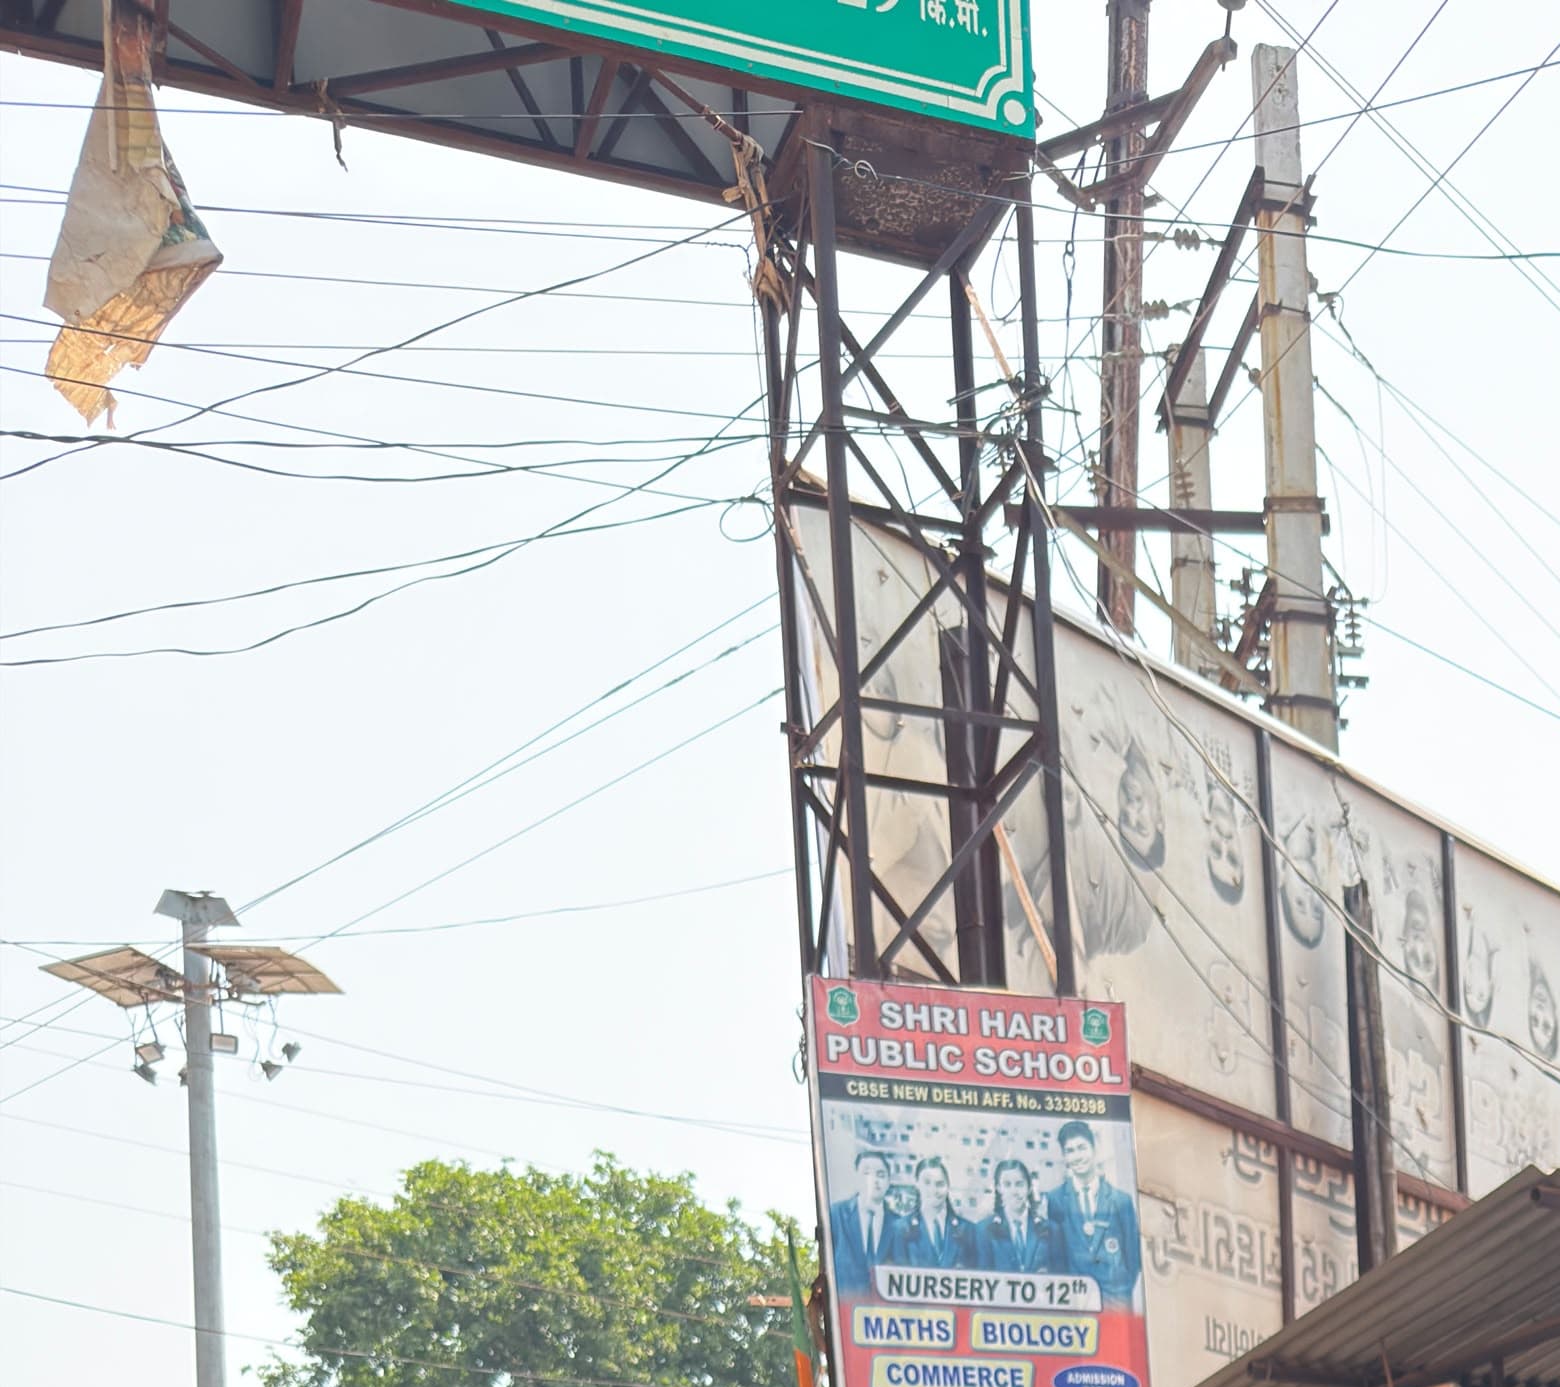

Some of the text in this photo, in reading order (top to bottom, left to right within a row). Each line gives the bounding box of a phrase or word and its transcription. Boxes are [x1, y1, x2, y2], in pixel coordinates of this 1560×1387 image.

[880, 1000, 1067, 1043] SHRI HARI
[826, 1034, 1122, 1084] PUBLIC SCHOOL
[846, 1081, 1106, 1114] CBSE NEW DELHI AFF. No. 3330398
[888, 1273, 1088, 1305] NURSERY TO 12th
[863, 1315, 950, 1343] MATHS
[982, 1322, 1090, 1348] BIOLOGY
[1067, 1372, 1125, 1386] ADMISSION
